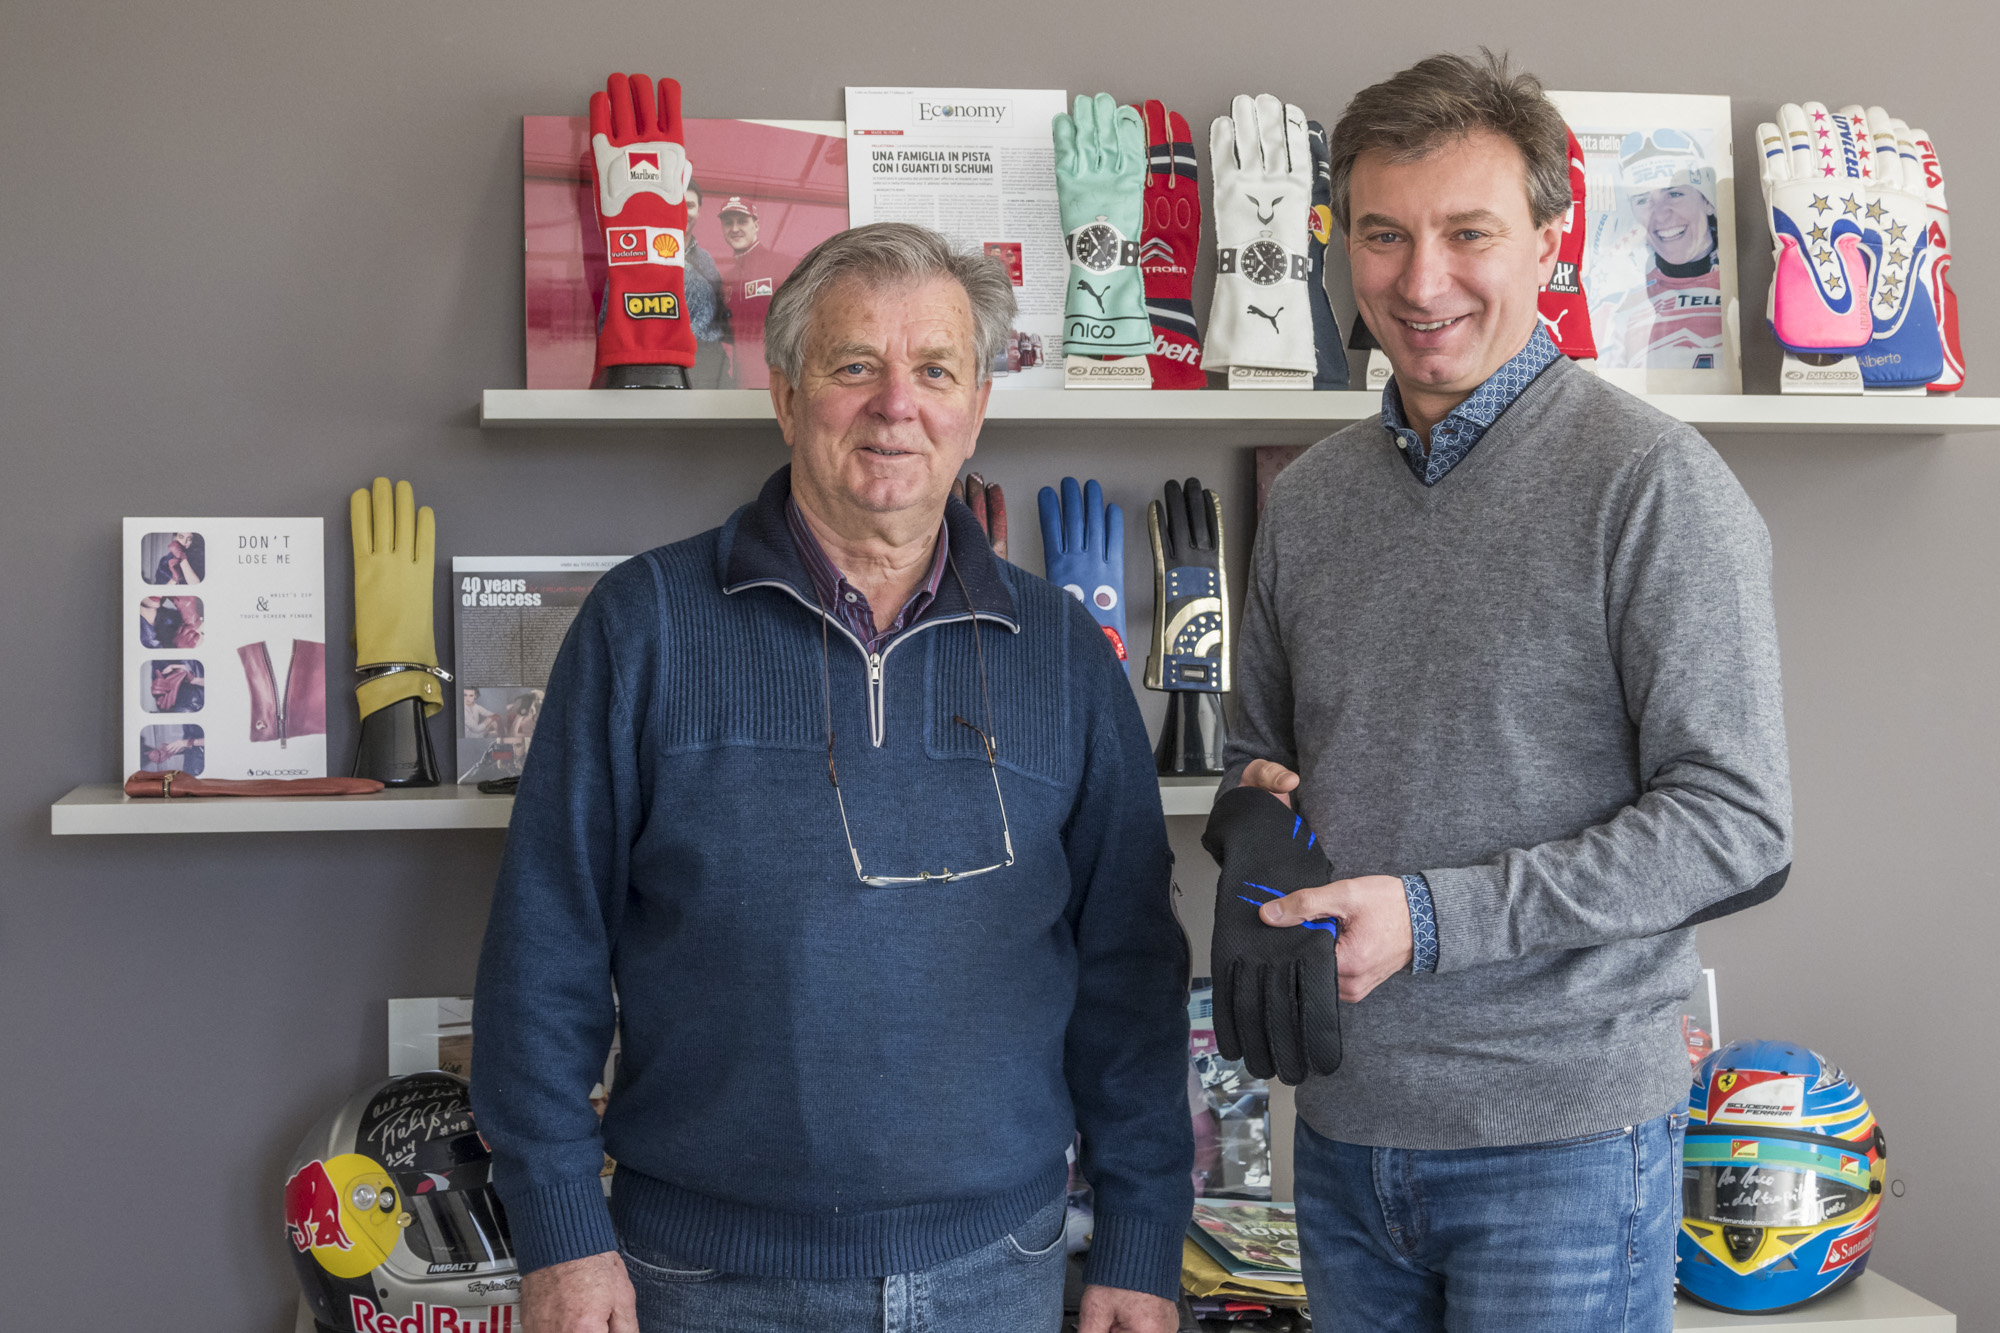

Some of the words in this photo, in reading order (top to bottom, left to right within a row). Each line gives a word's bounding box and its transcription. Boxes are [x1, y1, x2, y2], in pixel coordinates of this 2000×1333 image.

[919, 102, 1006, 123] Economy
[1578, 135, 1598, 151] etta
[872, 151, 894, 161] UNA
[897, 151, 945, 162] FAMIGLIA
[948, 152, 959, 162] IN
[962, 152, 991, 162] PISTA
[1915, 140, 1942, 188] FILA
[630, 169, 659, 180] Marlboro
[872, 163, 893, 173] CON
[902, 163, 939, 173] GUANTI
[942, 164, 952, 173] DI
[954, 164, 993, 174] SCHUMI
[1550, 283, 1578, 293] HUBLOT
[628, 296, 675, 314] OMP
[1153, 334, 1200, 365] belt
[1857, 353, 1902, 368] Alberto
[238, 554, 267, 565] LOSE
[276, 554, 291, 564] ME
[461, 576, 481, 593] 40
[483, 578, 527, 594] years
[256, 596, 270, 612] &
[462, 592, 477, 606] of
[479, 592, 542, 607] success
[1726, 1102, 1781, 1111] SCUDERIA
[429, 1262, 476, 1273] IMPACT
[352, 1297, 424, 1333] Red
[432, 1305, 513, 1333] Bull
